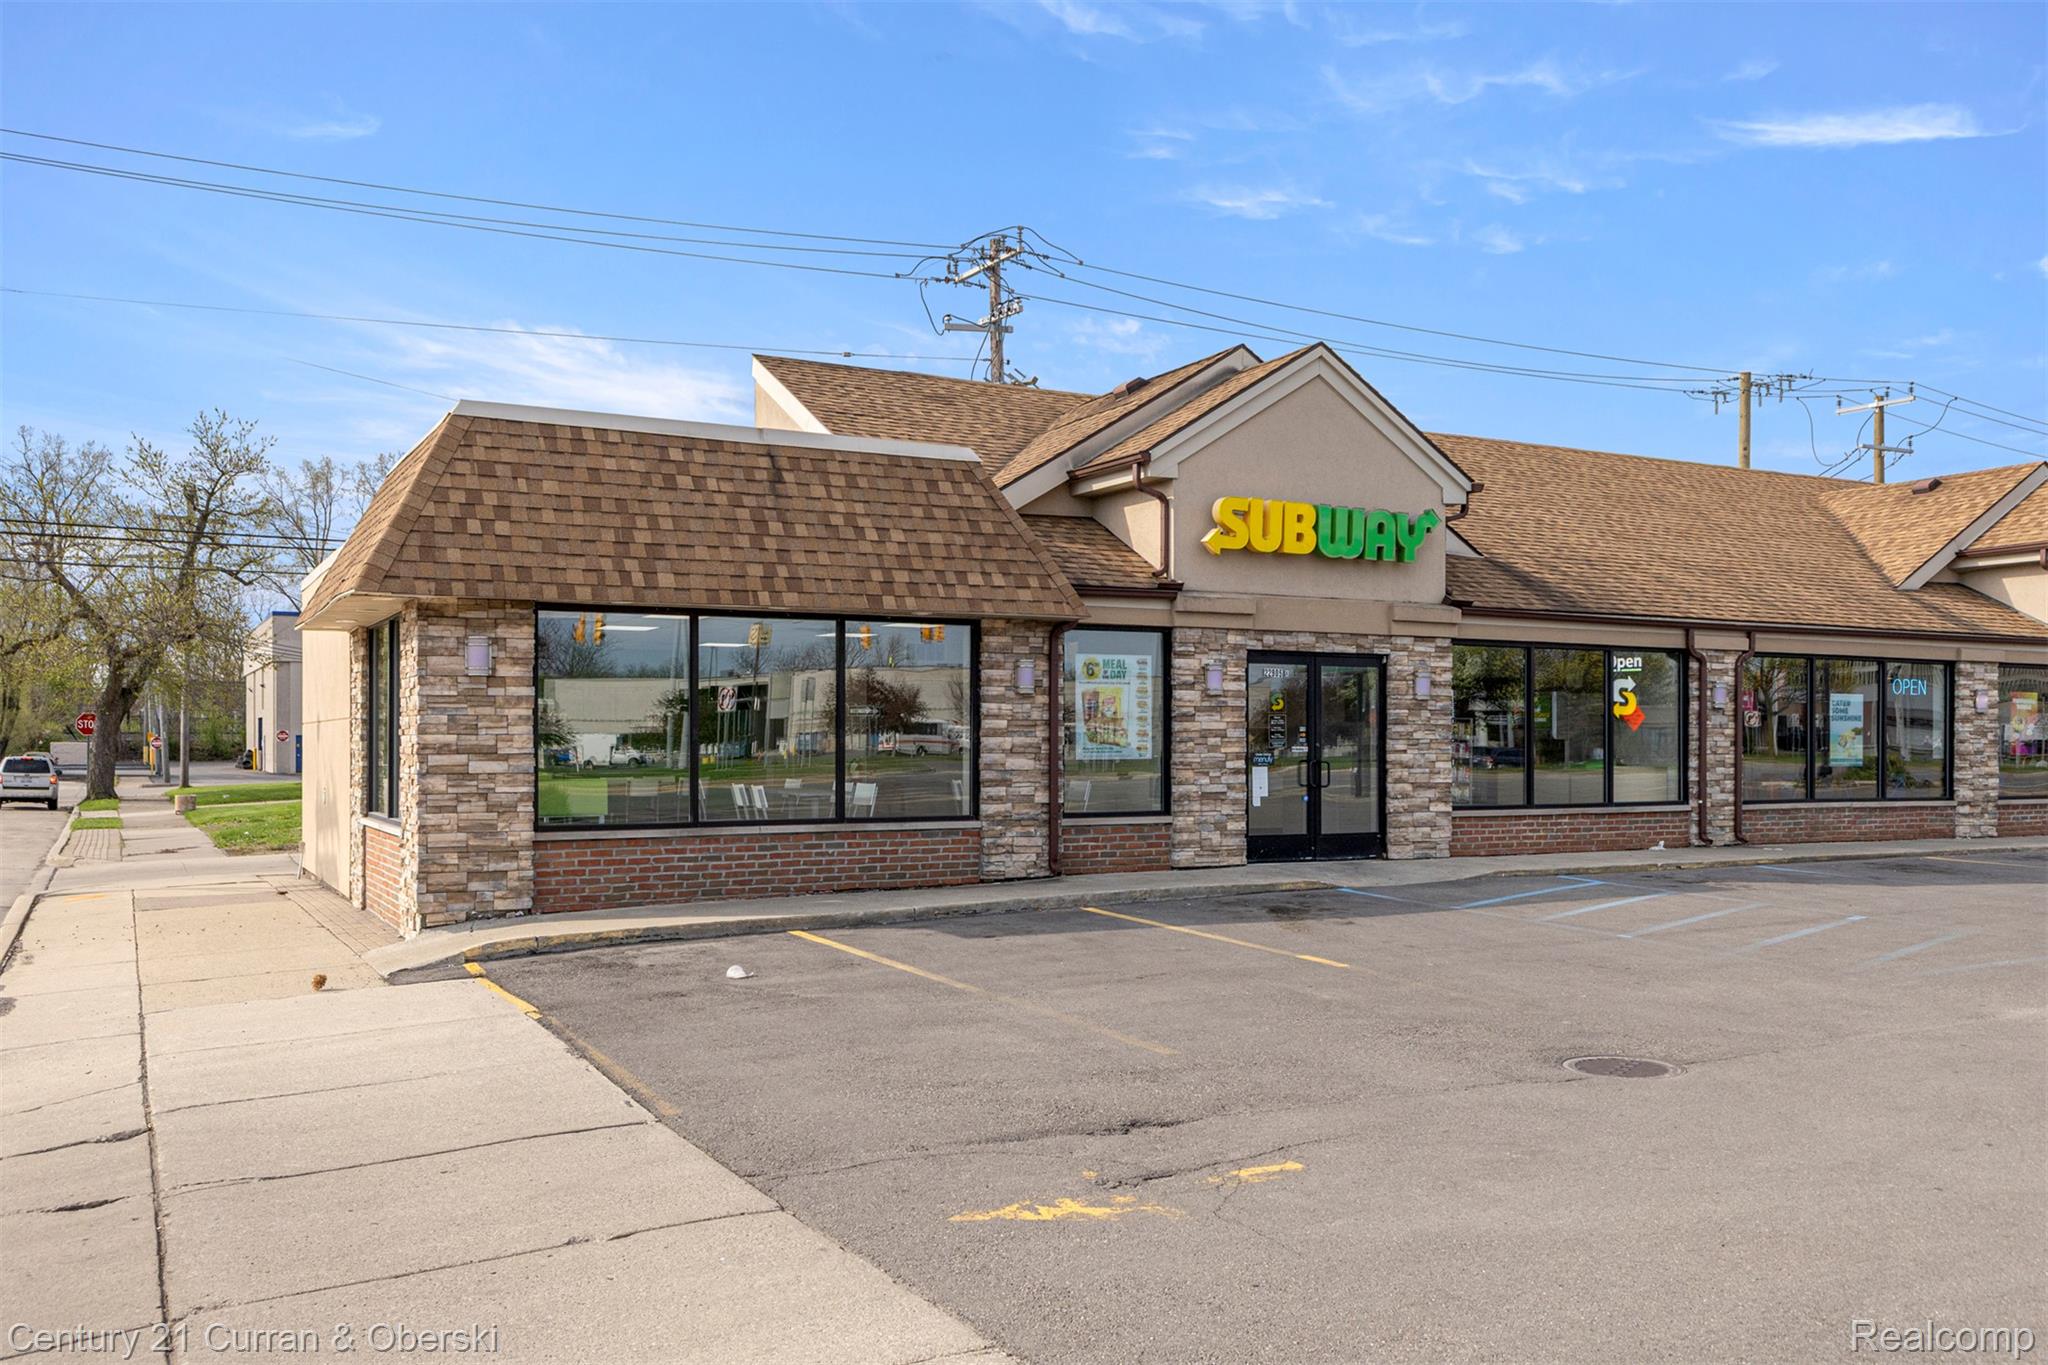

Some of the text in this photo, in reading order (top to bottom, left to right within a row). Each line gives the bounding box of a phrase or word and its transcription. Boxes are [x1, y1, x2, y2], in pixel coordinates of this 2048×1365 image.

[1200, 496, 1441, 563] SUBWAY
[1103, 659, 1127, 669] MEAL
[1110, 670, 1127, 679] DAY
[1892, 679, 1927, 695] OPEN
[77, 720, 95, 729] STO
